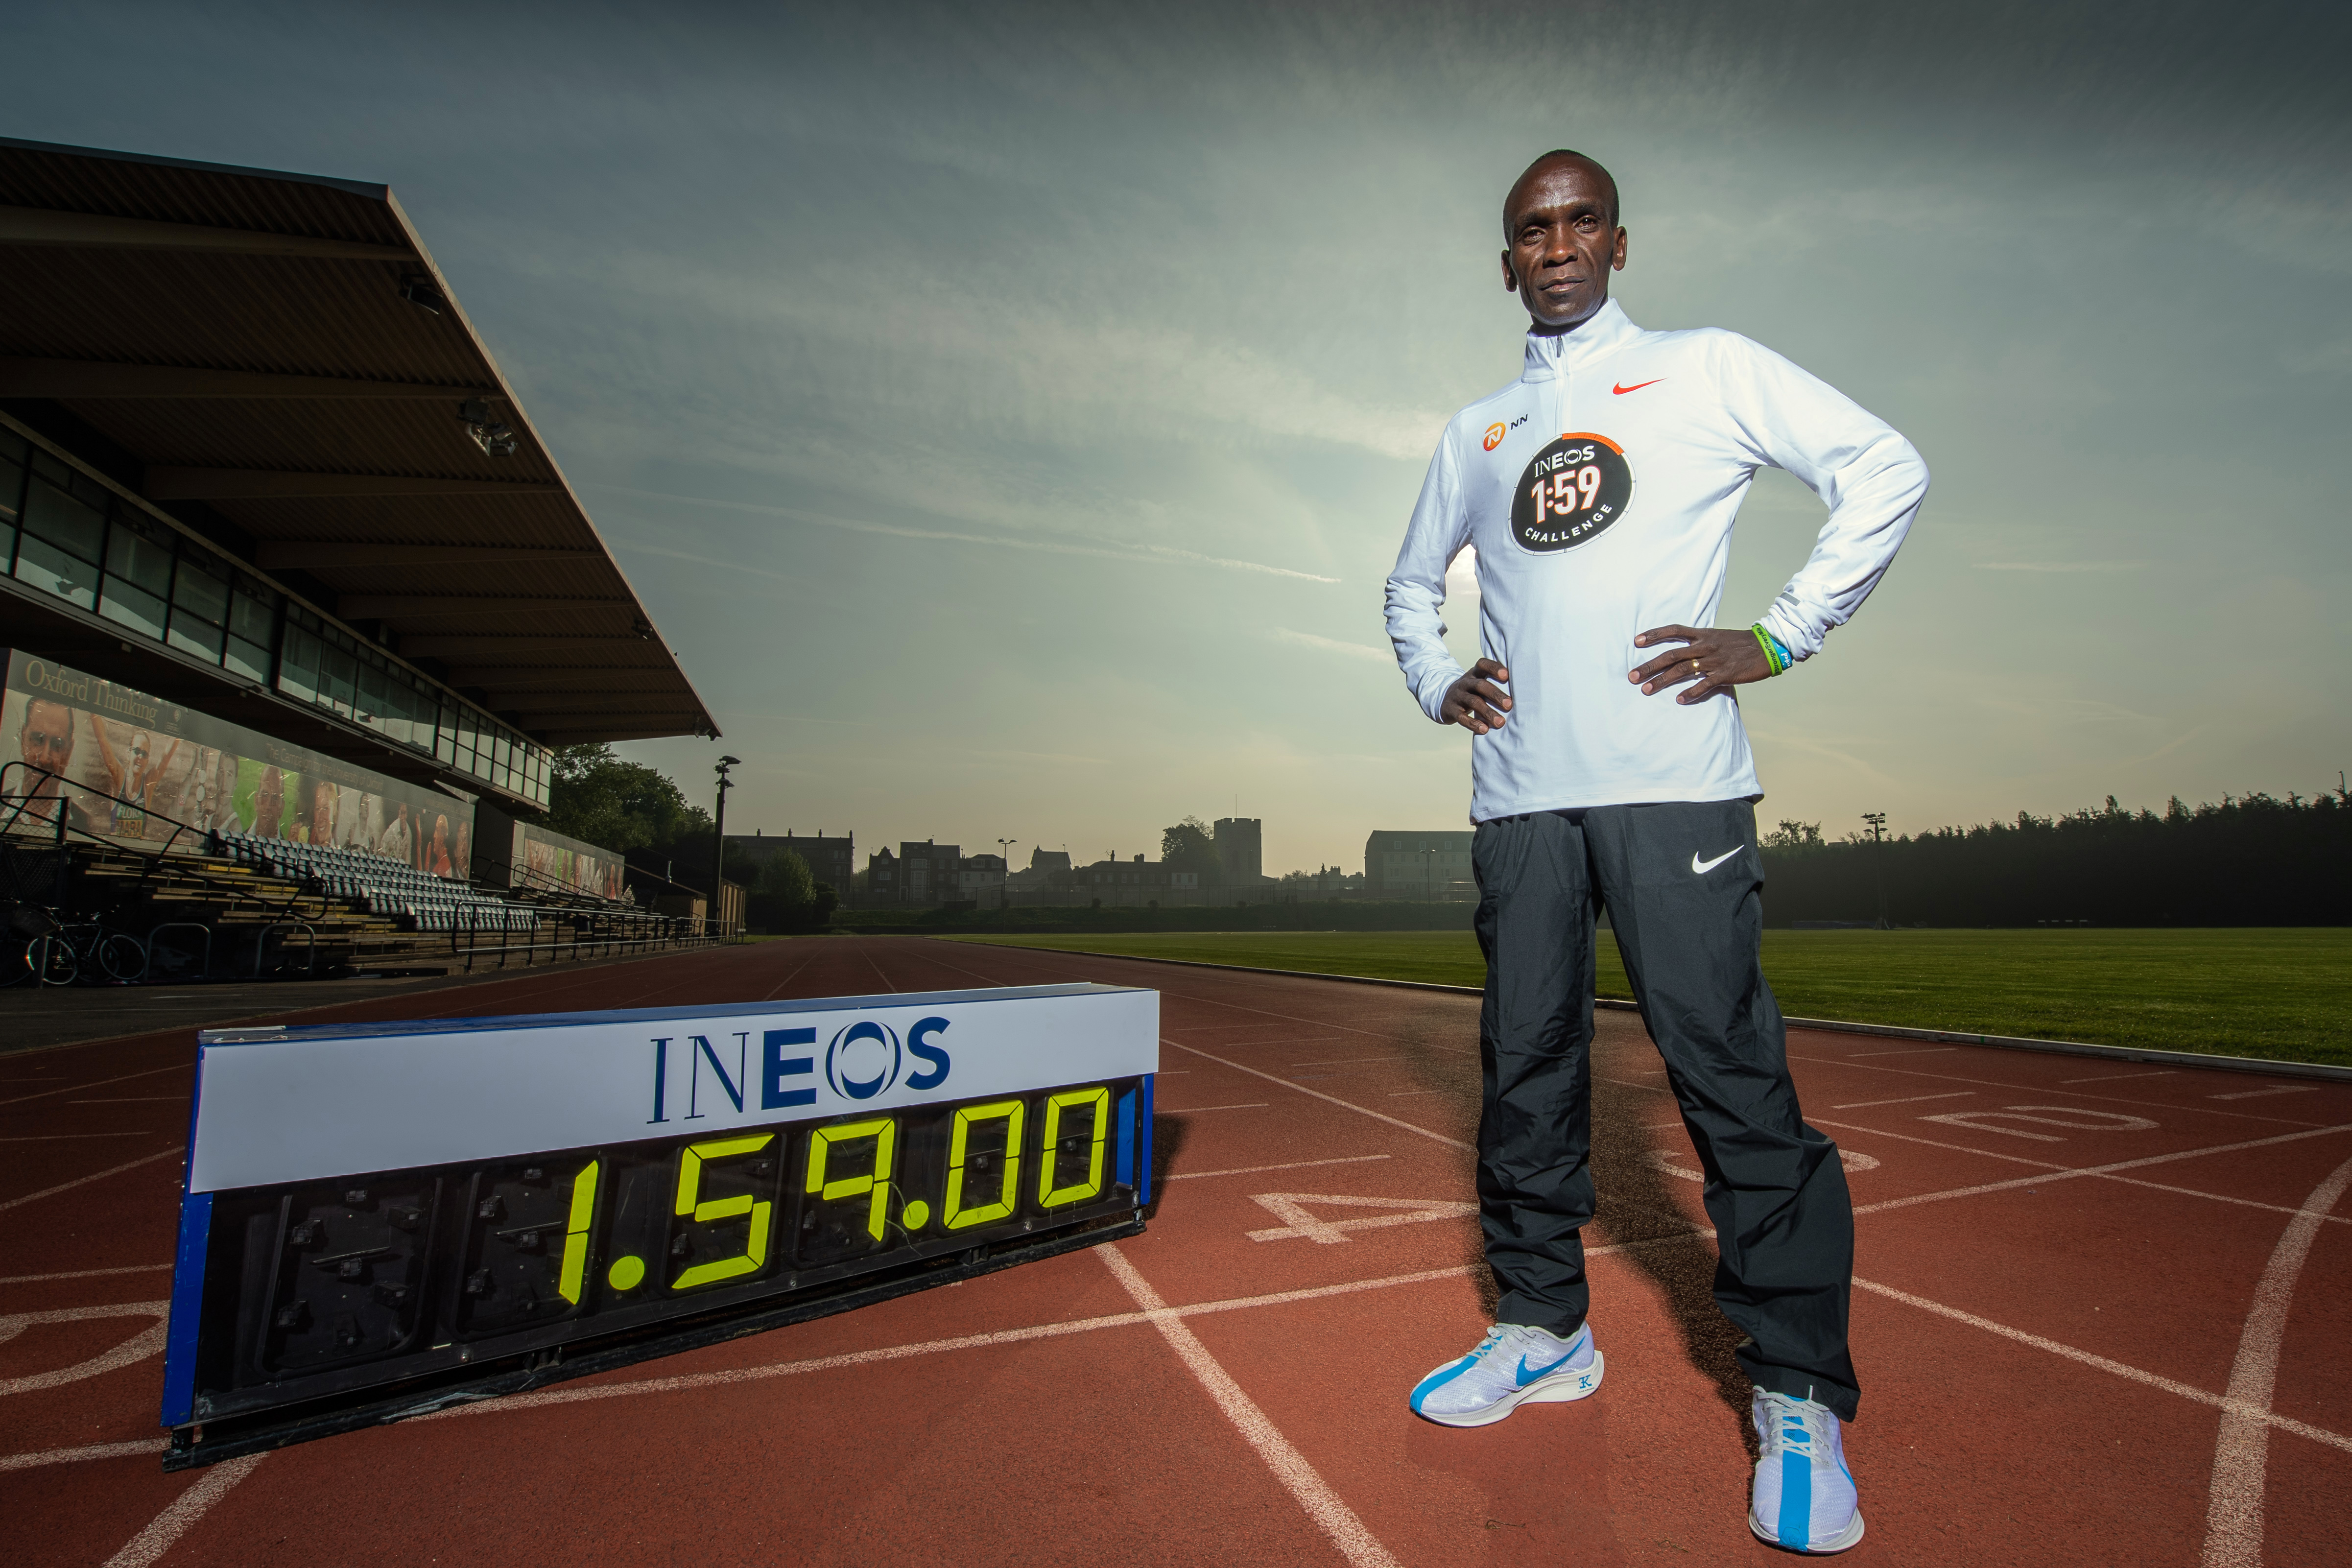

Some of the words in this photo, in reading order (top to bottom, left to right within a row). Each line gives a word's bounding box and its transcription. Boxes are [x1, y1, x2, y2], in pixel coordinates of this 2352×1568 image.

[1511, 414, 1528, 430] NN
[1535, 445, 1595, 478] INEOS
[1531, 465, 1601, 523] 1:59
[1525, 504, 1613, 542] CHALLENGE
[26, 660, 88, 702] Oxford
[93, 680, 158, 729] Thinking
[266, 743, 279, 759] The
[118, 805, 143, 818] FLORA
[646, 1016, 951, 1124] INEOS
[1245, 1192, 1481, 1244] 4
